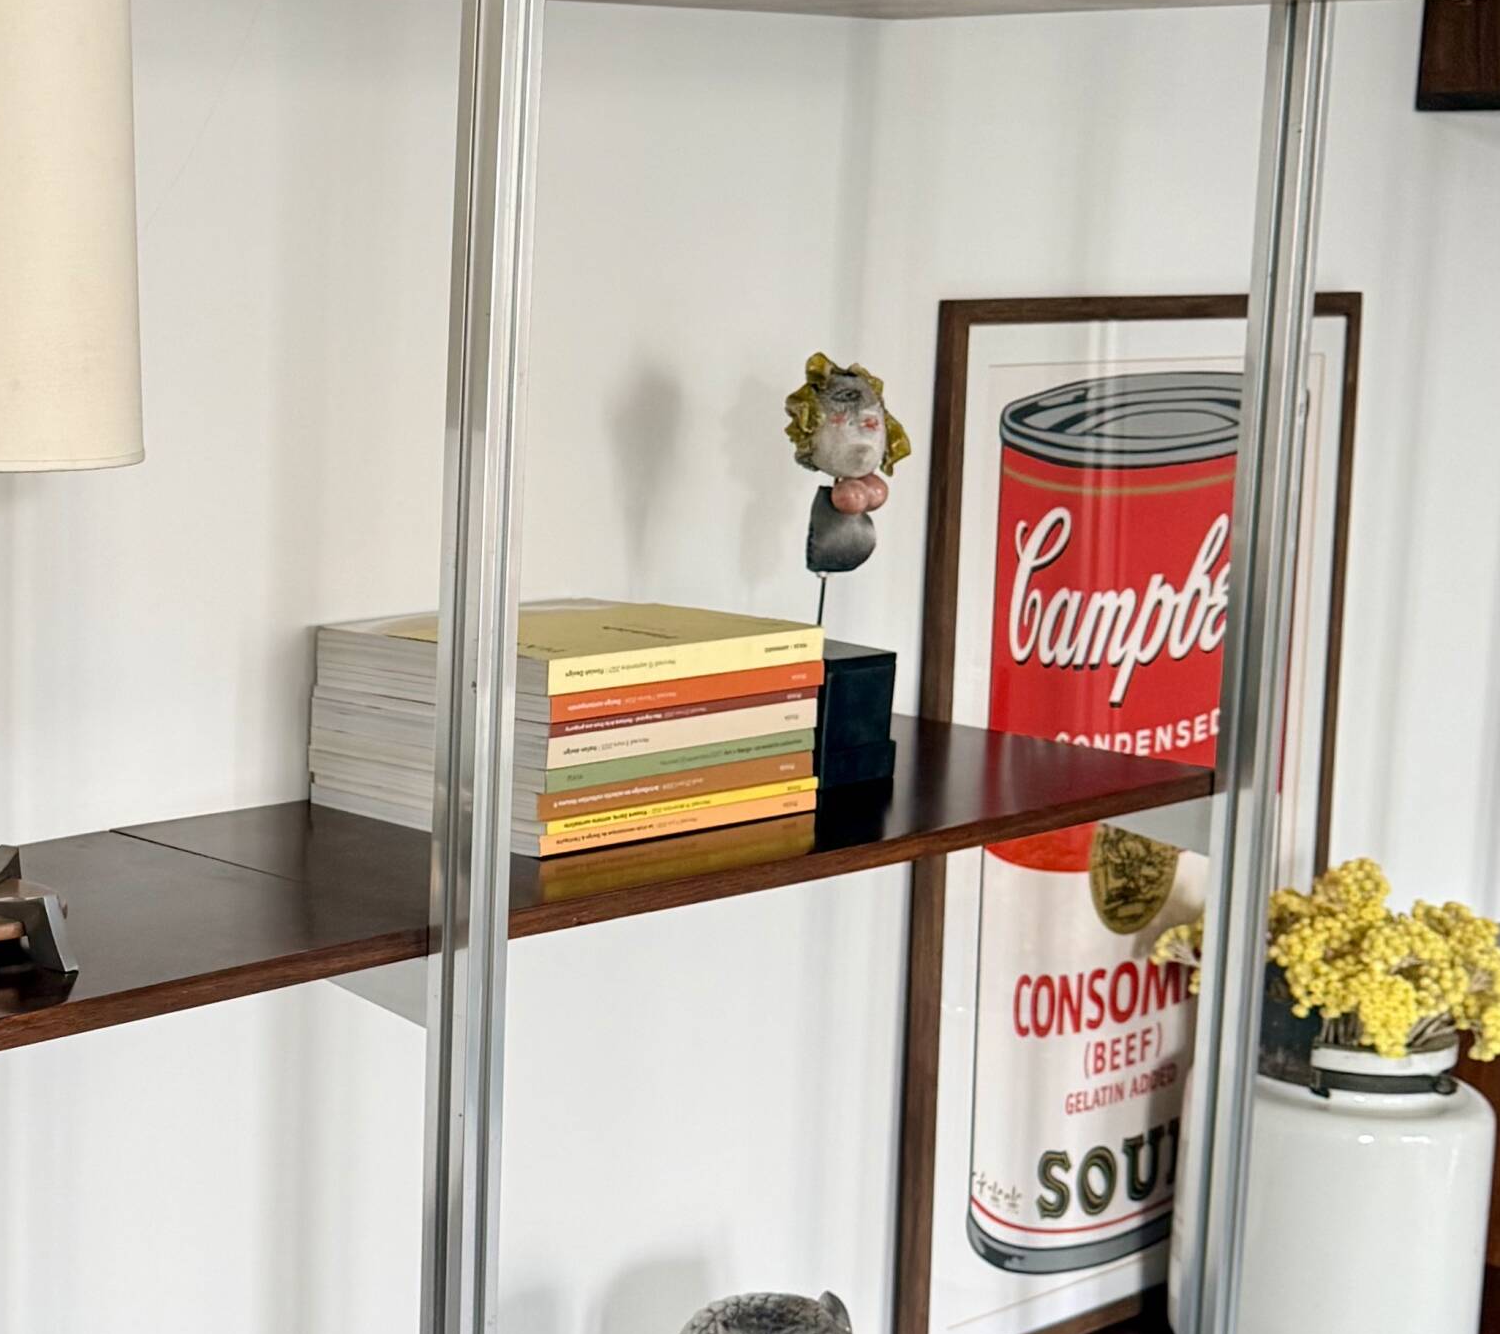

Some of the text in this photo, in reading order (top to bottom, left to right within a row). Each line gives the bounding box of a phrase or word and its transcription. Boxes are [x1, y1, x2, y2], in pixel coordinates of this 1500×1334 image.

[1009, 507, 1229, 707] Campbe
[1013, 957, 1192, 1038] CONSOM
[1084, 1022, 1162, 1078] (BEEF)
[1065, 1063, 1177, 1115] GELATIN ADDED
